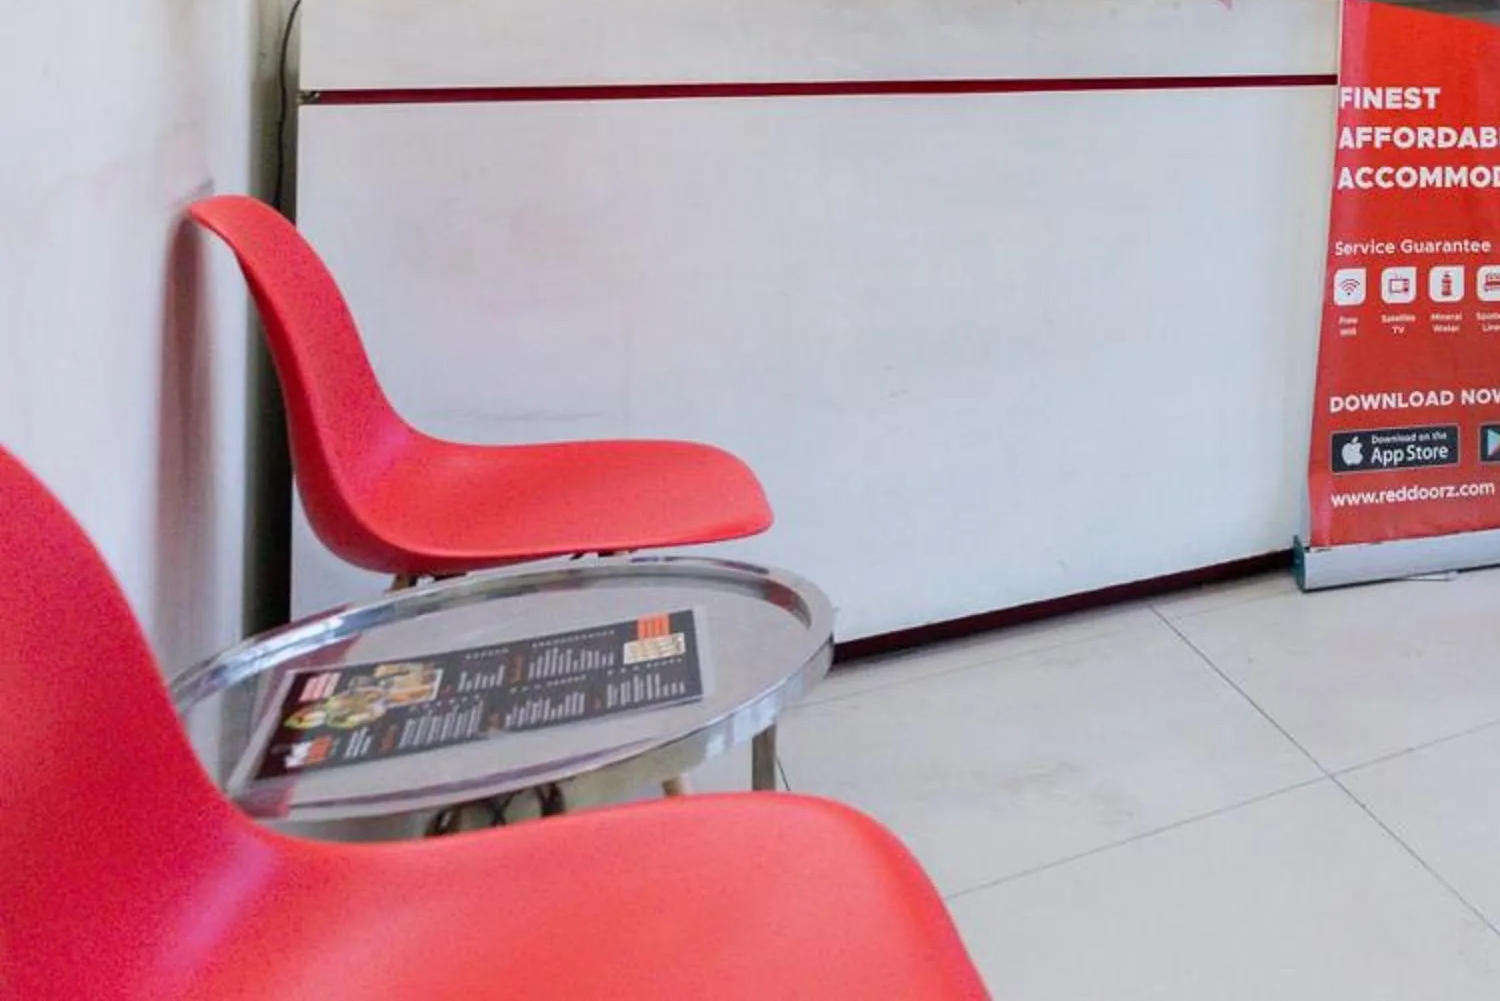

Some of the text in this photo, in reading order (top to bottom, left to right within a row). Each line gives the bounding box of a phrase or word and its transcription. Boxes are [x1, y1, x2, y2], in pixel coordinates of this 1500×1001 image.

[1339, 86, 1441, 110] FINEST
[1335, 239, 1492, 256] Service Guarantee
[1430, 312, 1463, 322] Mineral
[1392, 326, 1405, 335] TV
[1433, 324, 1460, 333] Water
[1329, 390, 1455, 413] DOWNLOAD
[1371, 431, 1448, 444] Download on the
[1371, 444, 1449, 466] App Store
[1330, 481, 1496, 507] www.reddoorz.com
